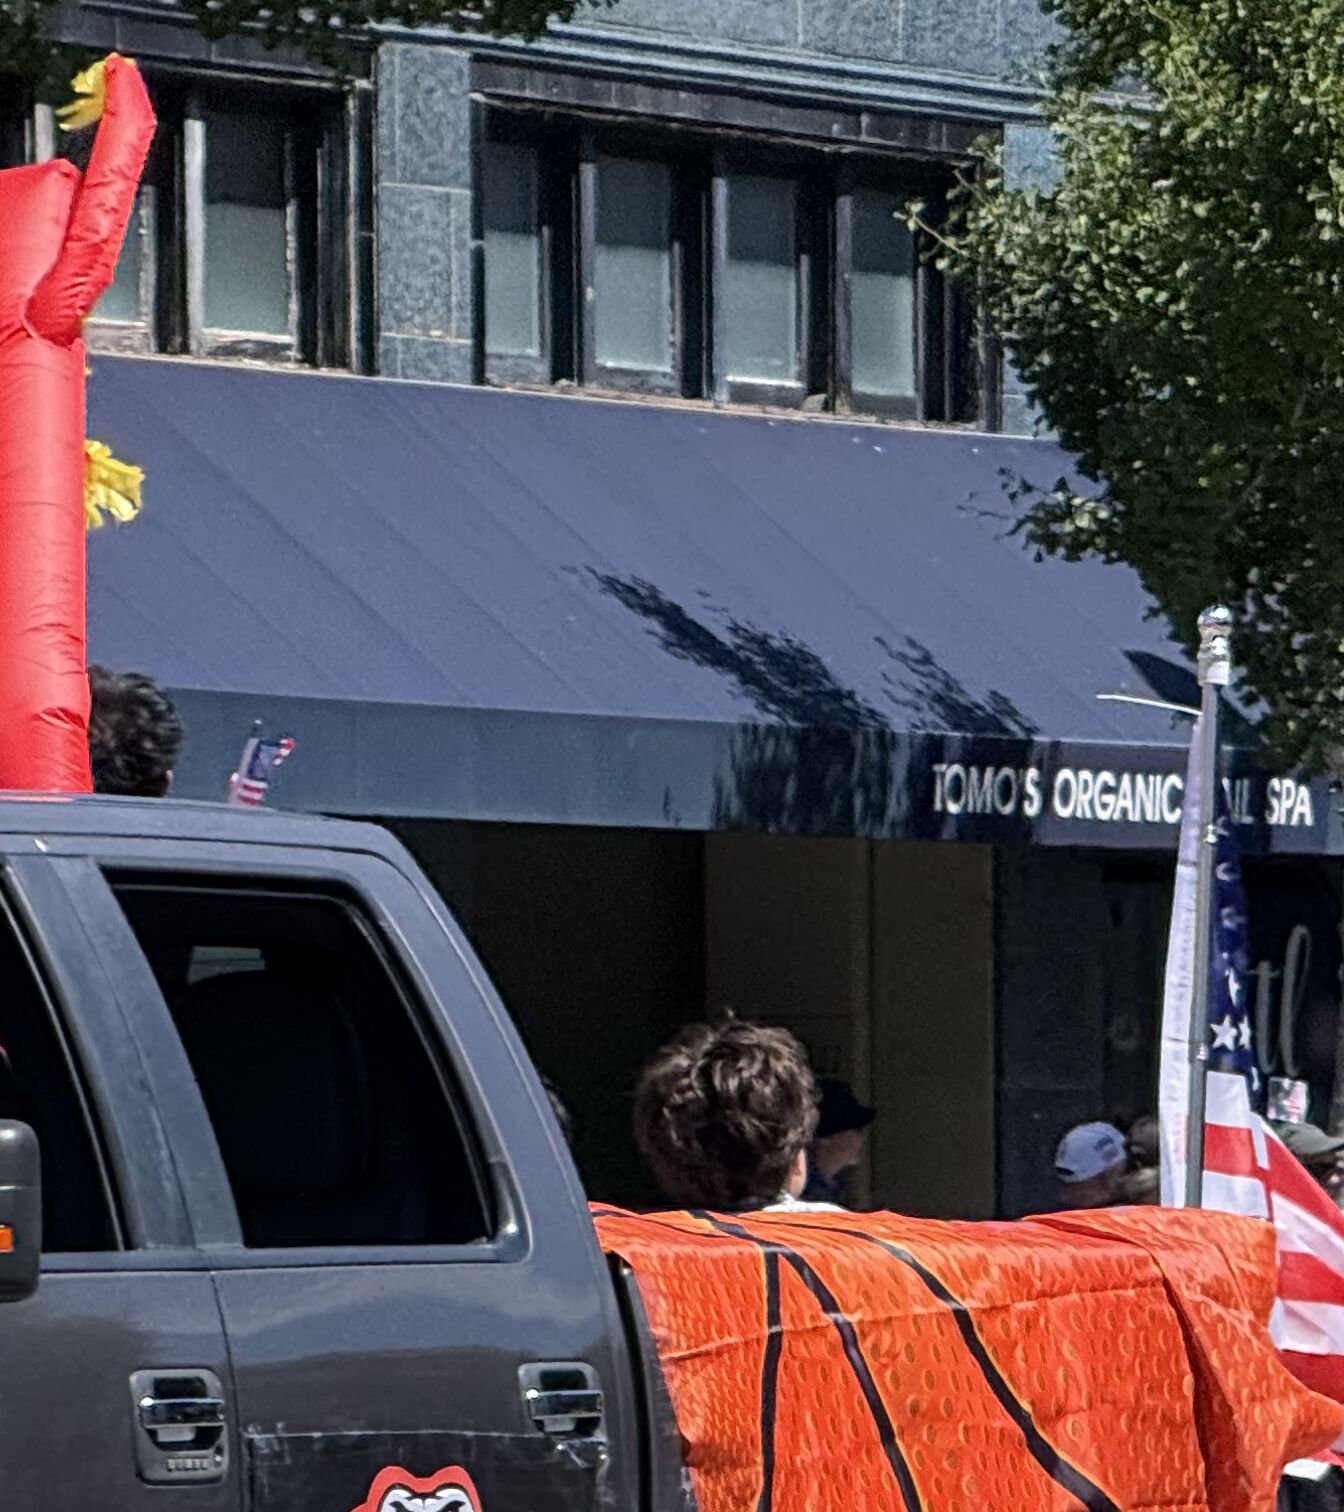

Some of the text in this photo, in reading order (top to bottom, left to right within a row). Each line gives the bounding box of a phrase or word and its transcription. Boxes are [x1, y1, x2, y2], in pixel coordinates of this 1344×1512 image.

[932, 763, 1042, 817] TOMO'S
[1053, 767, 1184, 825] ORGANIC
[1266, 777, 1314, 827] SPA
